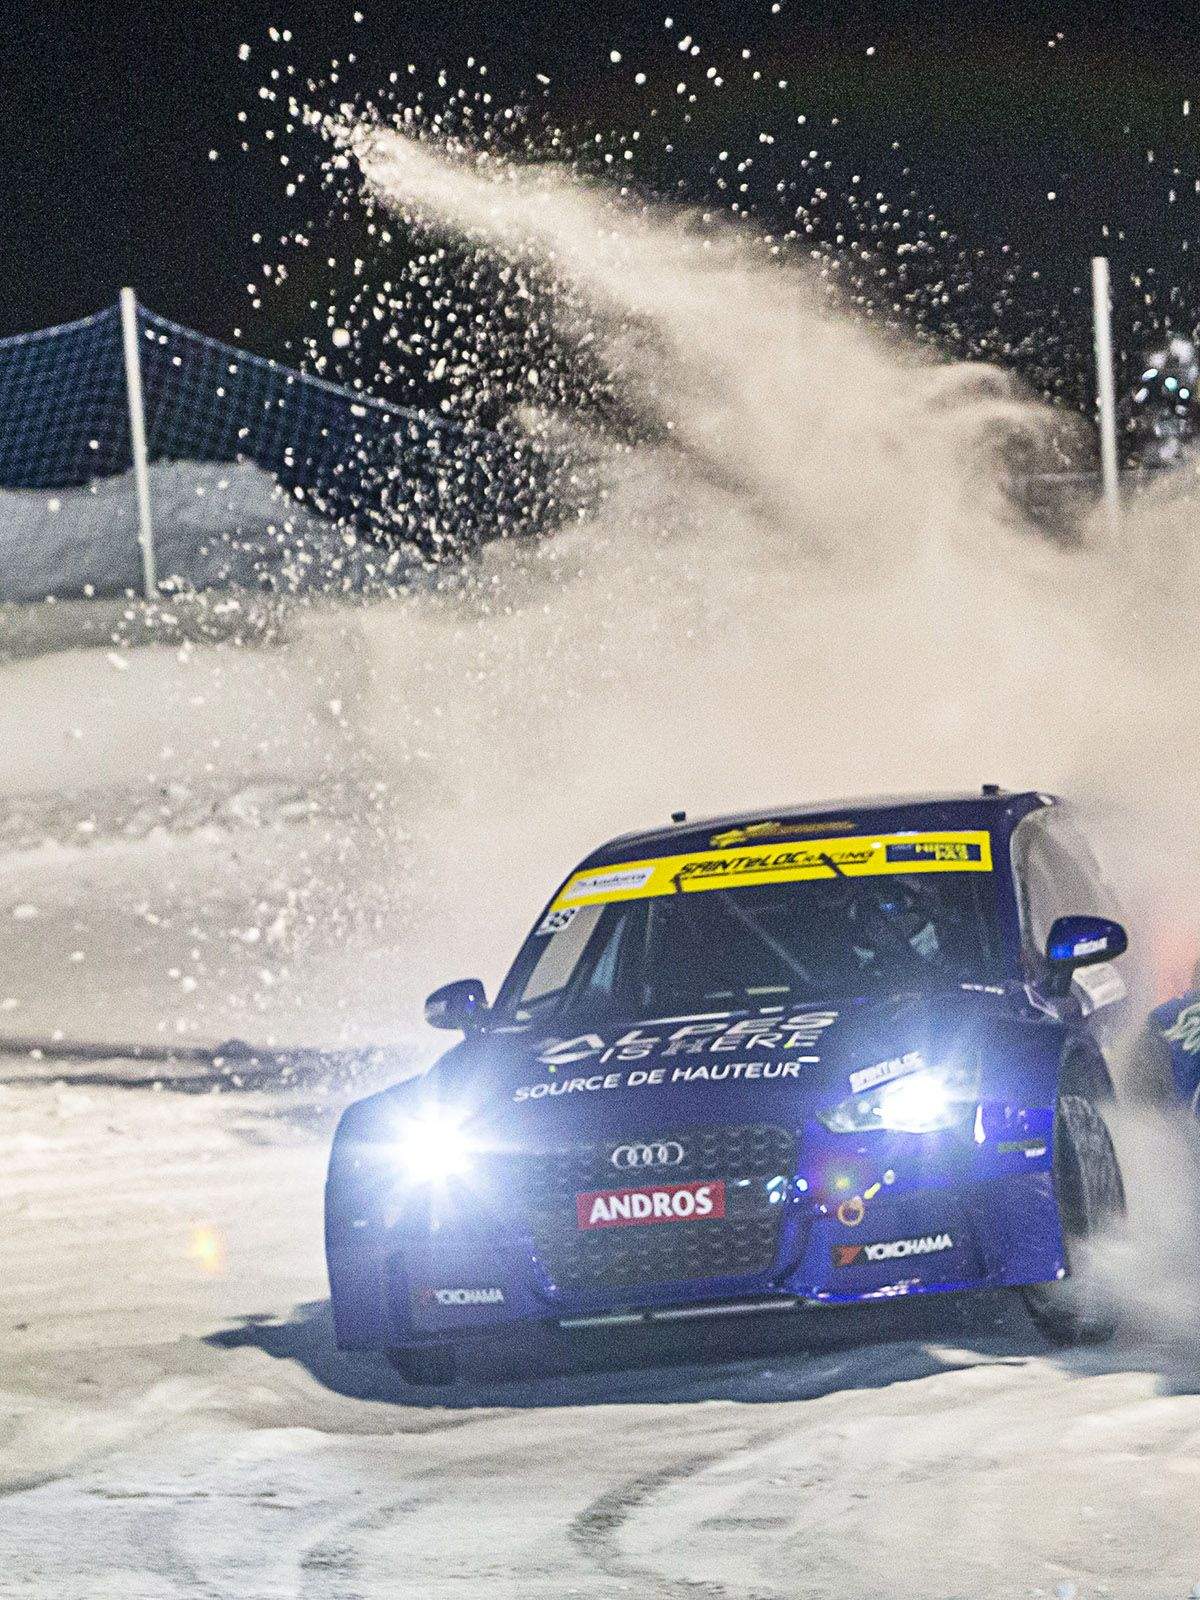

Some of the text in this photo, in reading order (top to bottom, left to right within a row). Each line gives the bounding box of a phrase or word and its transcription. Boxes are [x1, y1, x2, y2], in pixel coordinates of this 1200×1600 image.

[511, 1060, 801, 1101] SOURCE DE HAUTEUR
[590, 1186, 714, 1225] ANDROS
[864, 1233, 953, 1261] YOKOHAMA
